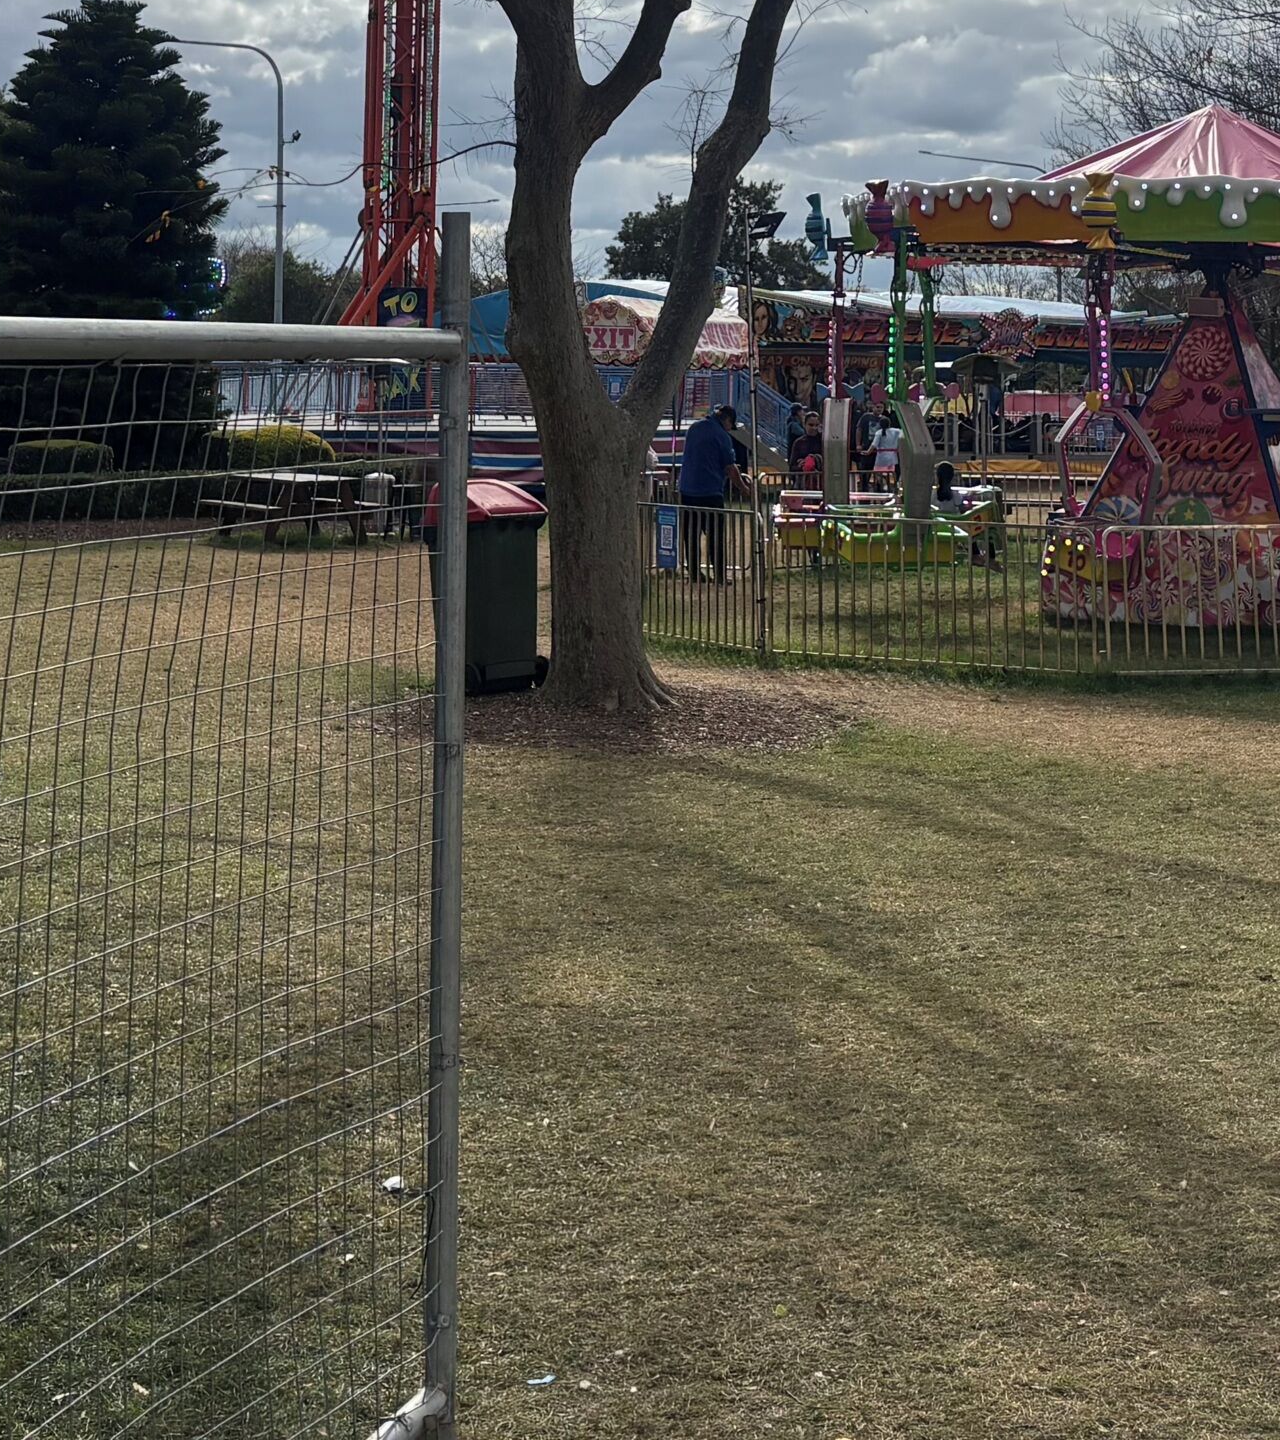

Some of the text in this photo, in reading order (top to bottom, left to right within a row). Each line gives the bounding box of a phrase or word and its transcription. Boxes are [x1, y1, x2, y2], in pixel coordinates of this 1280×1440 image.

[384, 291, 418, 317] TO
[583, 327, 634, 349] XIT
[1035, 324, 1172, 351] DODEMS
[758, 355, 784, 367] EAD
[1128, 428, 1252, 470] Candy
[1137, 453, 1253, 506] Swing
[1067, 550, 1086, 571] 10
